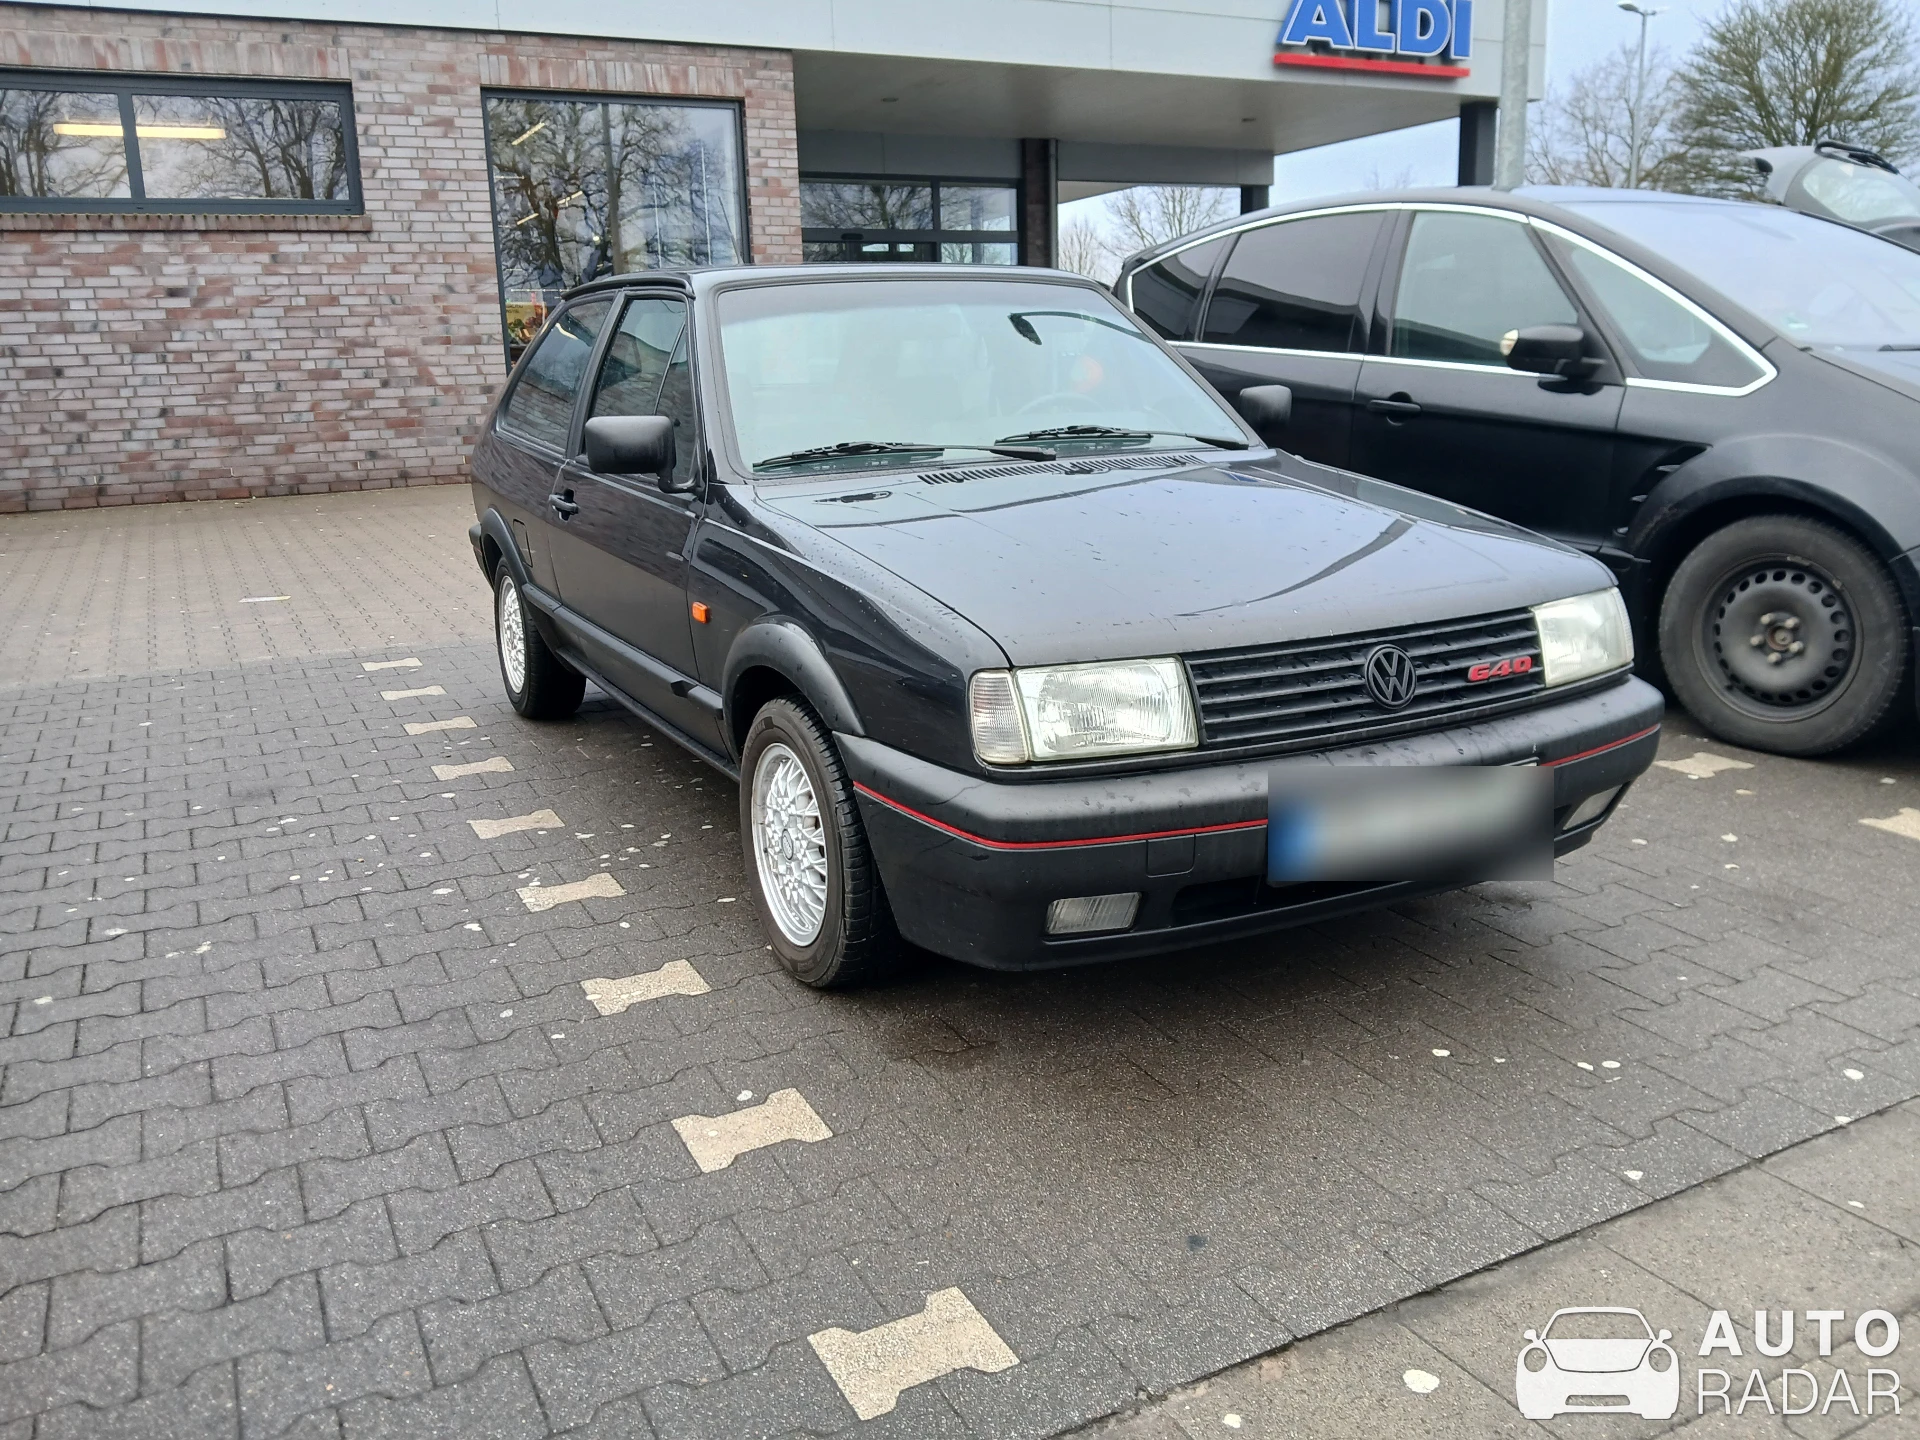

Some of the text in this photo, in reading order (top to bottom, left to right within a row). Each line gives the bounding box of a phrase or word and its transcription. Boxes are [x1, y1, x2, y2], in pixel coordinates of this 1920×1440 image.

[1277, 0, 1472, 60] ALDI
[1368, 646, 1414, 706] VW
[1467, 655, 1532, 682] G40
